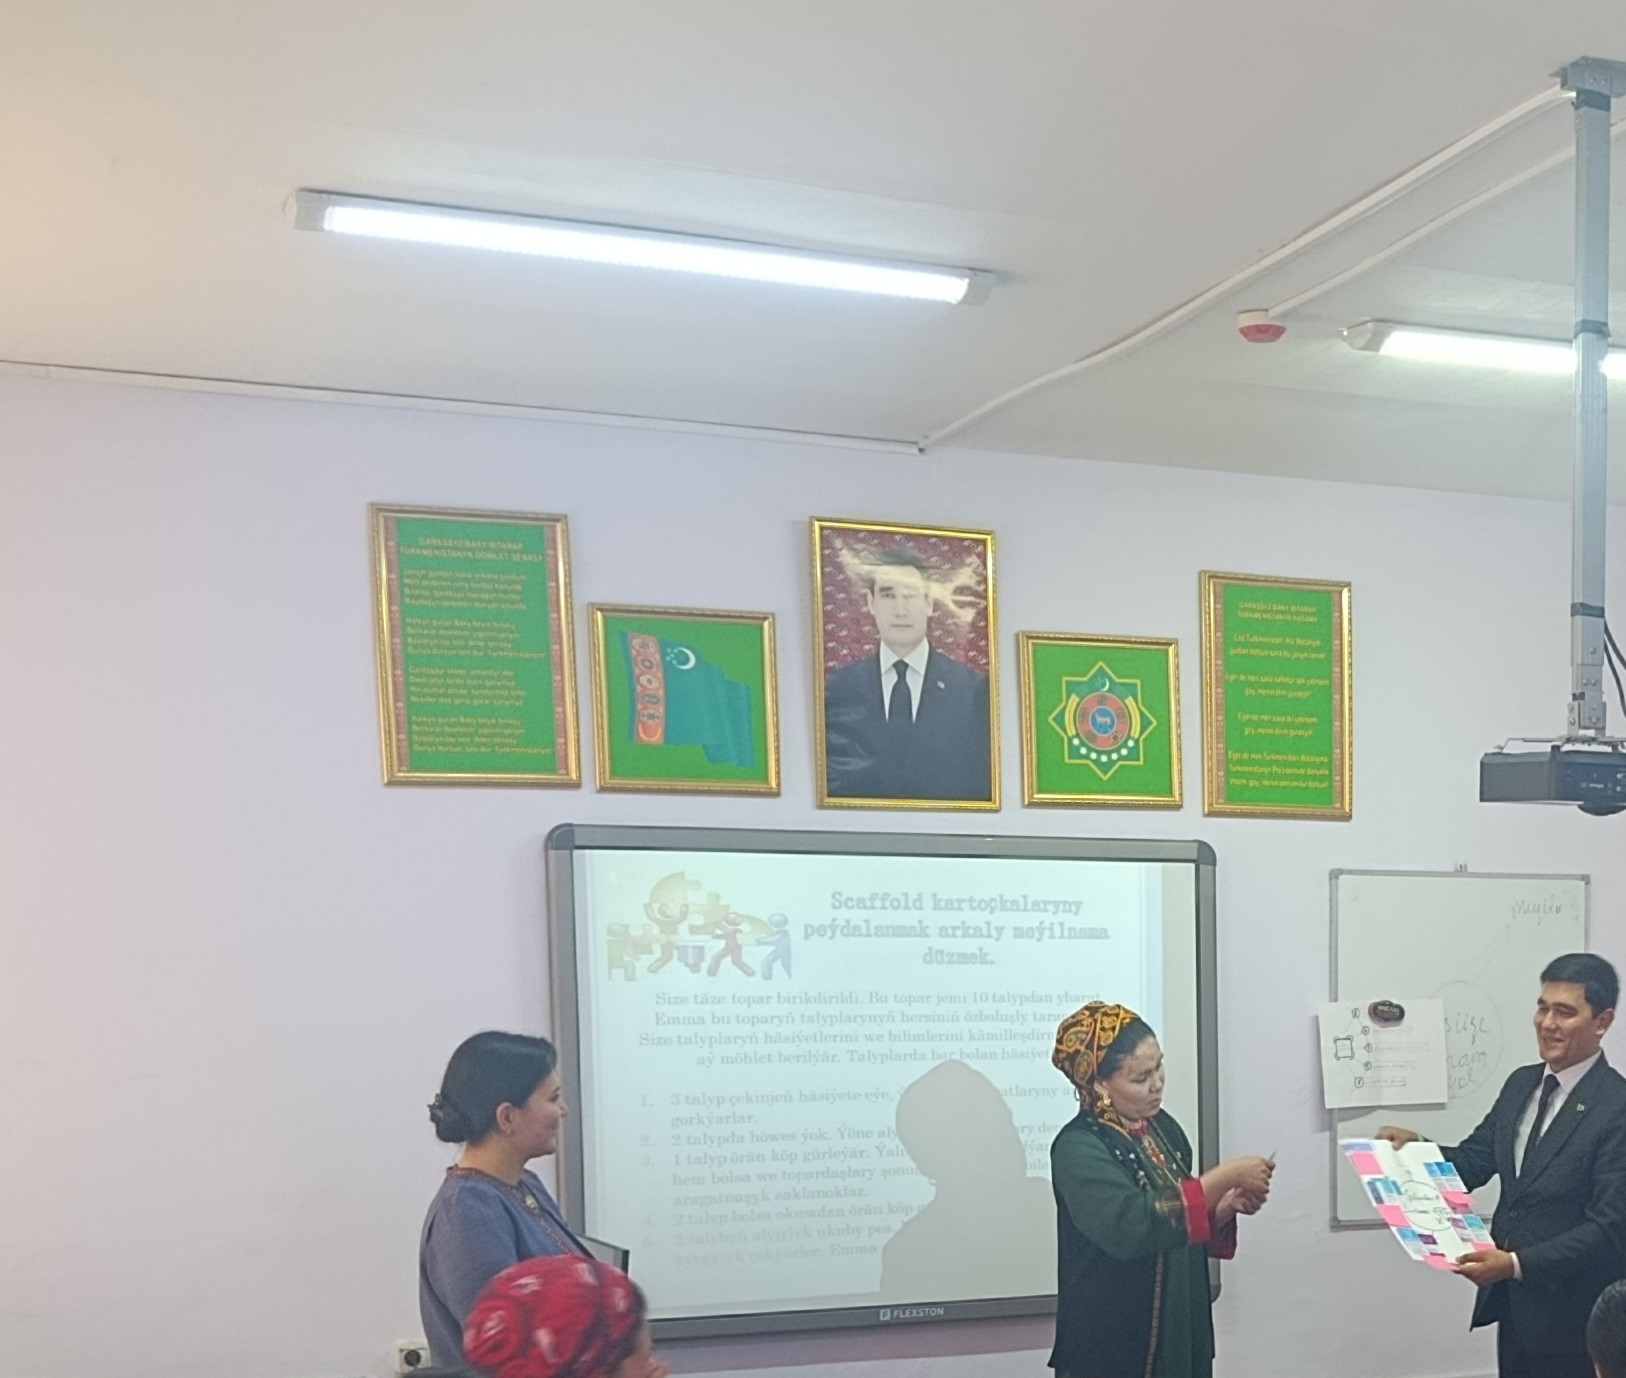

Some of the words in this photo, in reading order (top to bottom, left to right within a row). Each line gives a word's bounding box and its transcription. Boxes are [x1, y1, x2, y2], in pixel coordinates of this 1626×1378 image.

[831, 892, 925, 911] Scaffold
[932, 893, 1083, 915] kartoçkalaryny
[803, 918, 930, 940] peýdalanmak
[938, 920, 1005, 942] arkaly
[1012, 920, 1110, 942] meýilnama
[922, 946, 996, 965] düzmek.
[655, 992, 690, 1006] Size
[694, 992, 727, 1006] täze
[732, 992, 774, 1009] topar
[777, 991, 862, 1005] birikdirildi.
[869, 991, 888, 1004] Bu
[893, 992, 931, 1007] topar
[936, 991, 967, 1007] jemi
[973, 991, 989, 1004] 10
[992, 991, 1053, 1007] talypdan
[655, 1012, 706, 1026] Emma
[711, 1012, 733, 1025] bu
[736, 1011, 796, 1028] toparyň
[800, 1010, 896, 1027] talyplarynyň
[900, 1009, 960, 1024] hersiniň
[964, 1009, 1028, 1027] özboluşly
[639, 1032, 673, 1047] Size
[677, 1031, 759, 1048] talyplaryň
[764, 1030, 860, 1047] häsiýetlerini
[863, 1034, 885, 1044] we
[889, 1029, 964, 1043] bilimlerini
[696, 1053, 714, 1069] aý
[720, 1050, 774, 1065] möhlet
[778, 1049, 842, 1066] berilýär.
[847, 1048, 926, 1066] Talyplarda
[932, 1048, 955, 1061] bar
[960, 1048, 998, 1061] bolan
[640, 1094, 655, 1107] 1.
[670, 1093, 681, 1106] 3
[686, 1091, 725, 1109] talyp
[729, 1090, 794, 1108] çekinjeň
[799, 1088, 862, 1105] häsiýete
[671, 1111, 759, 1130] gorkýarlar.
[671, 1133, 682, 1147] 2
[687, 1131, 745, 1149] talypda
[750, 1129, 798, 1144] höwes
[801, 1126, 832, 1144] ýok.
[836, 1123, 875, 1140] Ýöne
[673, 1153, 680, 1167] 1
[686, 1151, 727, 1169] talyp
[730, 1151, 767, 1165] örän
[770, 1147, 799, 1165] köp
[803, 1146, 870, 1164] gürleýär.
[673, 1172, 706, 1187] hem
[711, 1170, 752, 1185] bolsa
[757, 1171, 778, 1183] we
[781, 1164, 876, 1182] topardaşlary
[672, 1190, 771, 1208] aragatnaşyk
[775, 1185, 869, 1202] saklanoklar.
[673, 1212, 684, 1227] 2
[688, 1210, 729, 1228] talyp
[732, 1208, 772, 1223] bolsa
[776, 1204, 845, 1221] okuwdan
[849, 1201, 884, 1216] örän
[887, 1200, 914, 1217] köp
[830, 1242, 878, 1257] Emma
[893, 1306, 945, 1319] FLEXSTON
